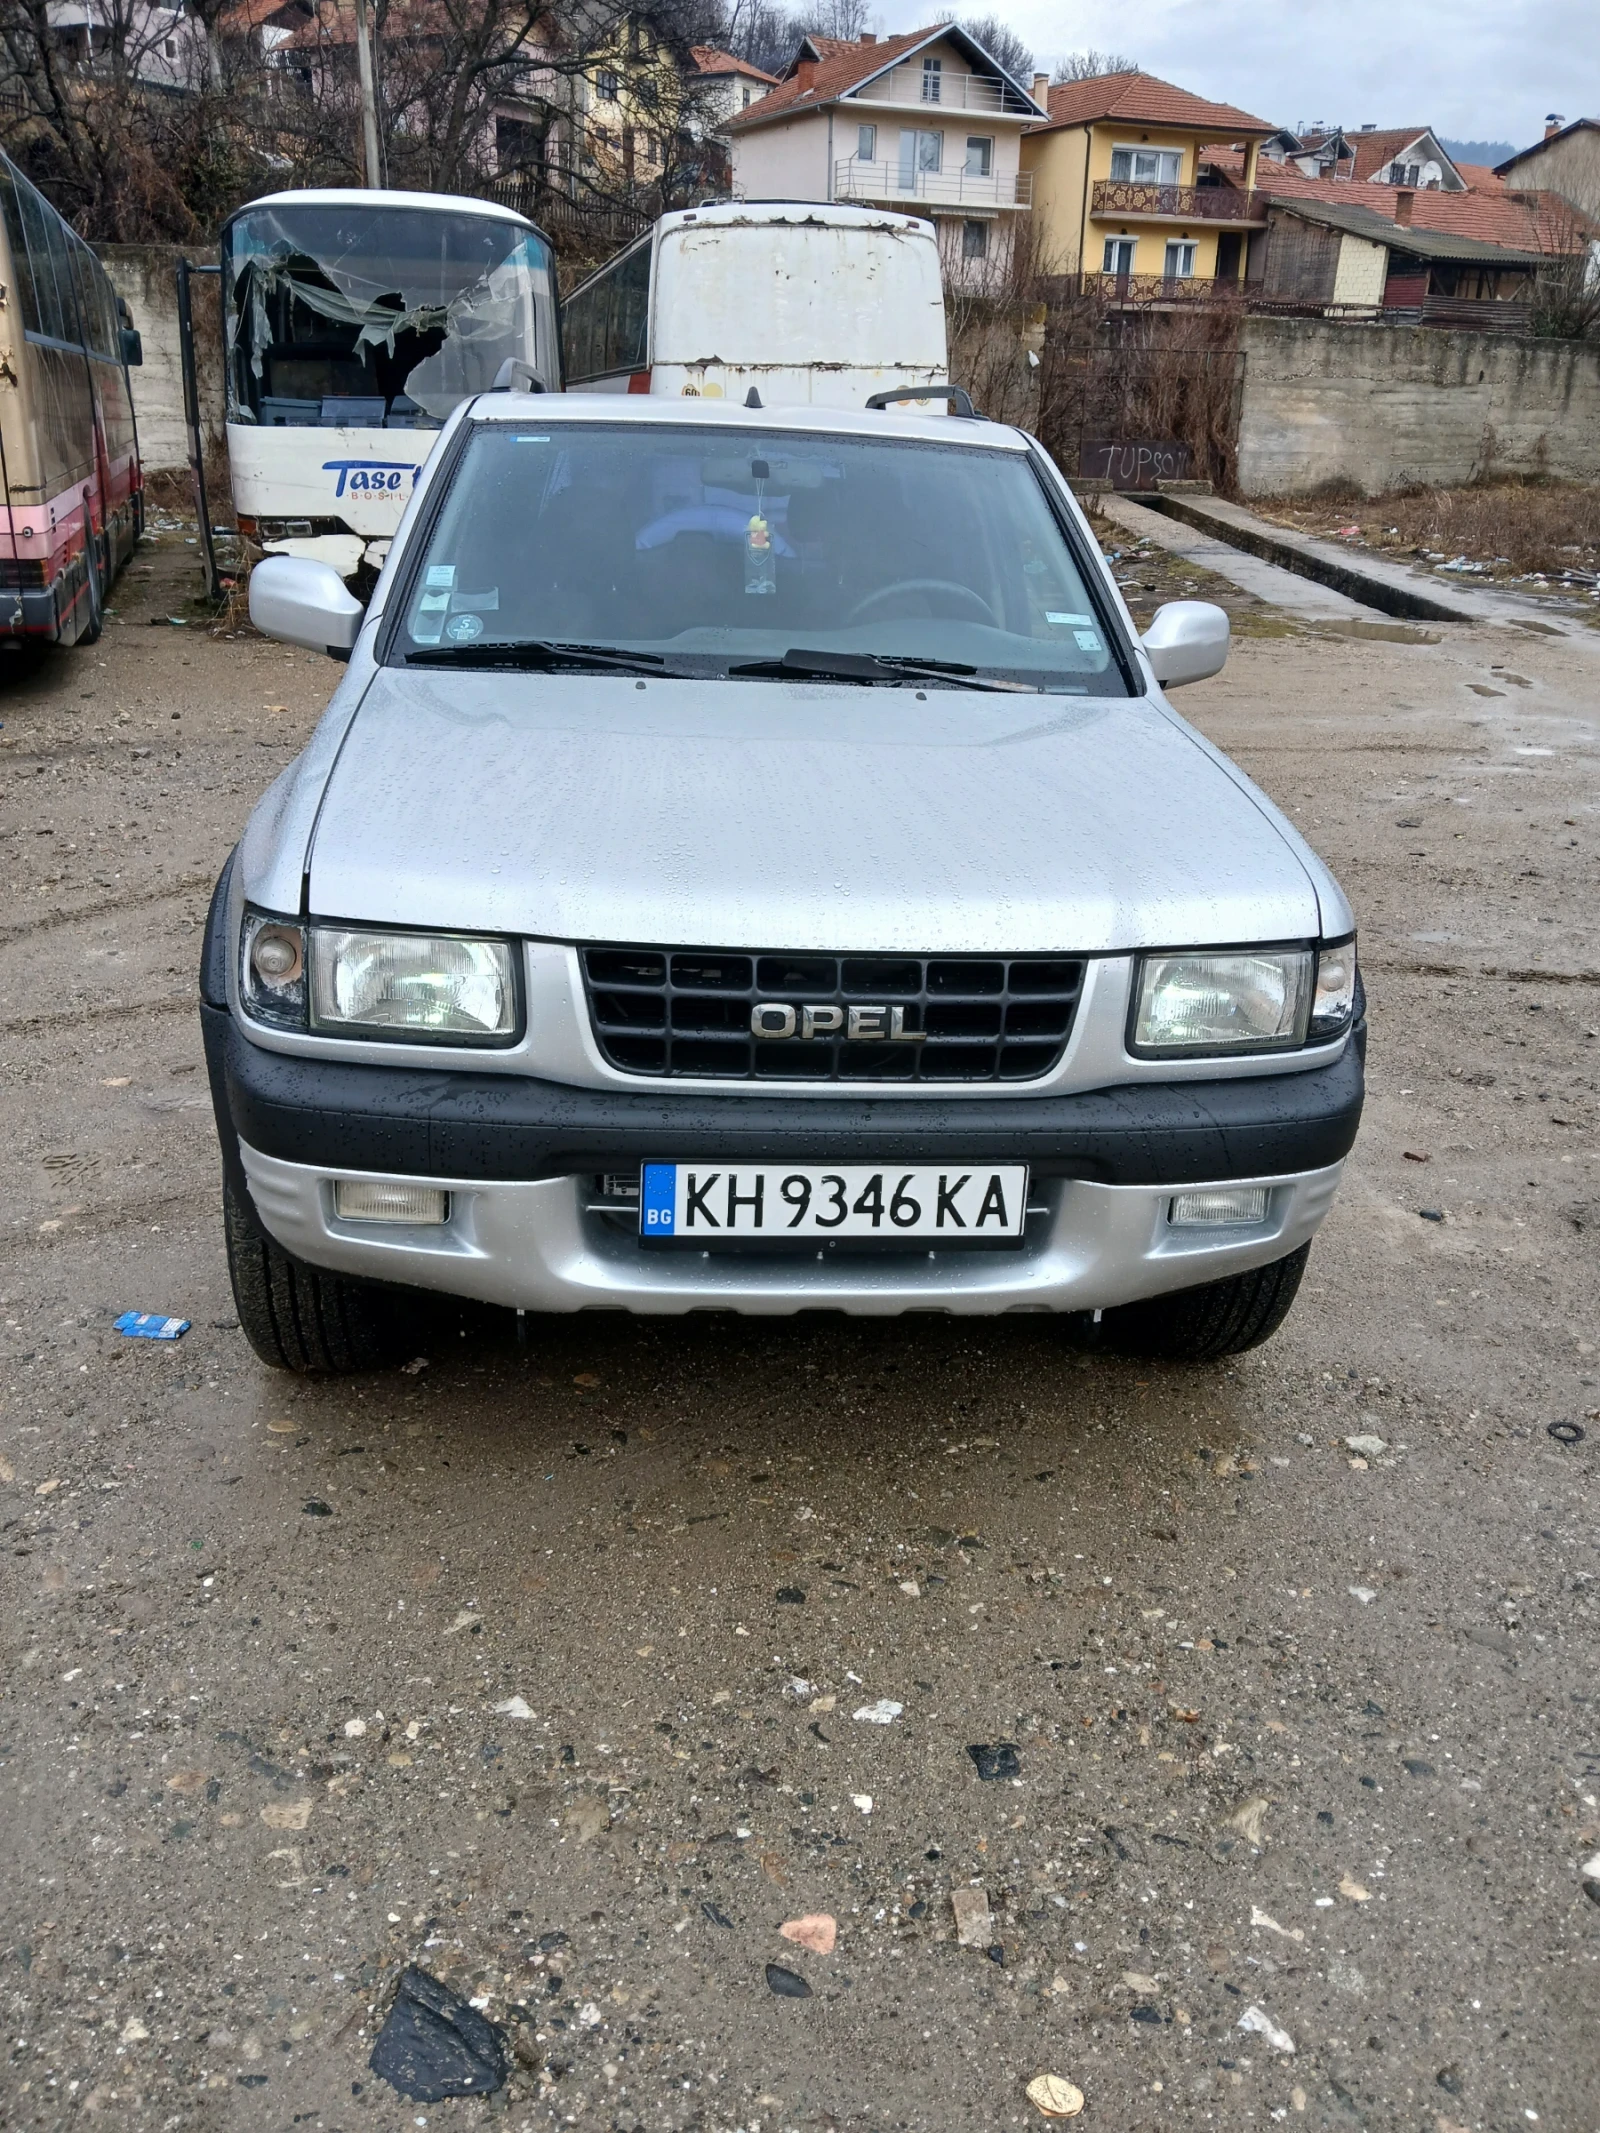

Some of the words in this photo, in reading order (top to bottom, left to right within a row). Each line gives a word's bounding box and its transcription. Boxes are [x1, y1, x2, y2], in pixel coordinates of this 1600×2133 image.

[321, 460, 417, 498] Tase
[751, 1003, 927, 1040] OPEL
[646, 1208, 672, 1226] BG
[685, 1173, 765, 1228] KH
[779, 1173, 922, 1228] 9346
[935, 1174, 1009, 1228] KA
